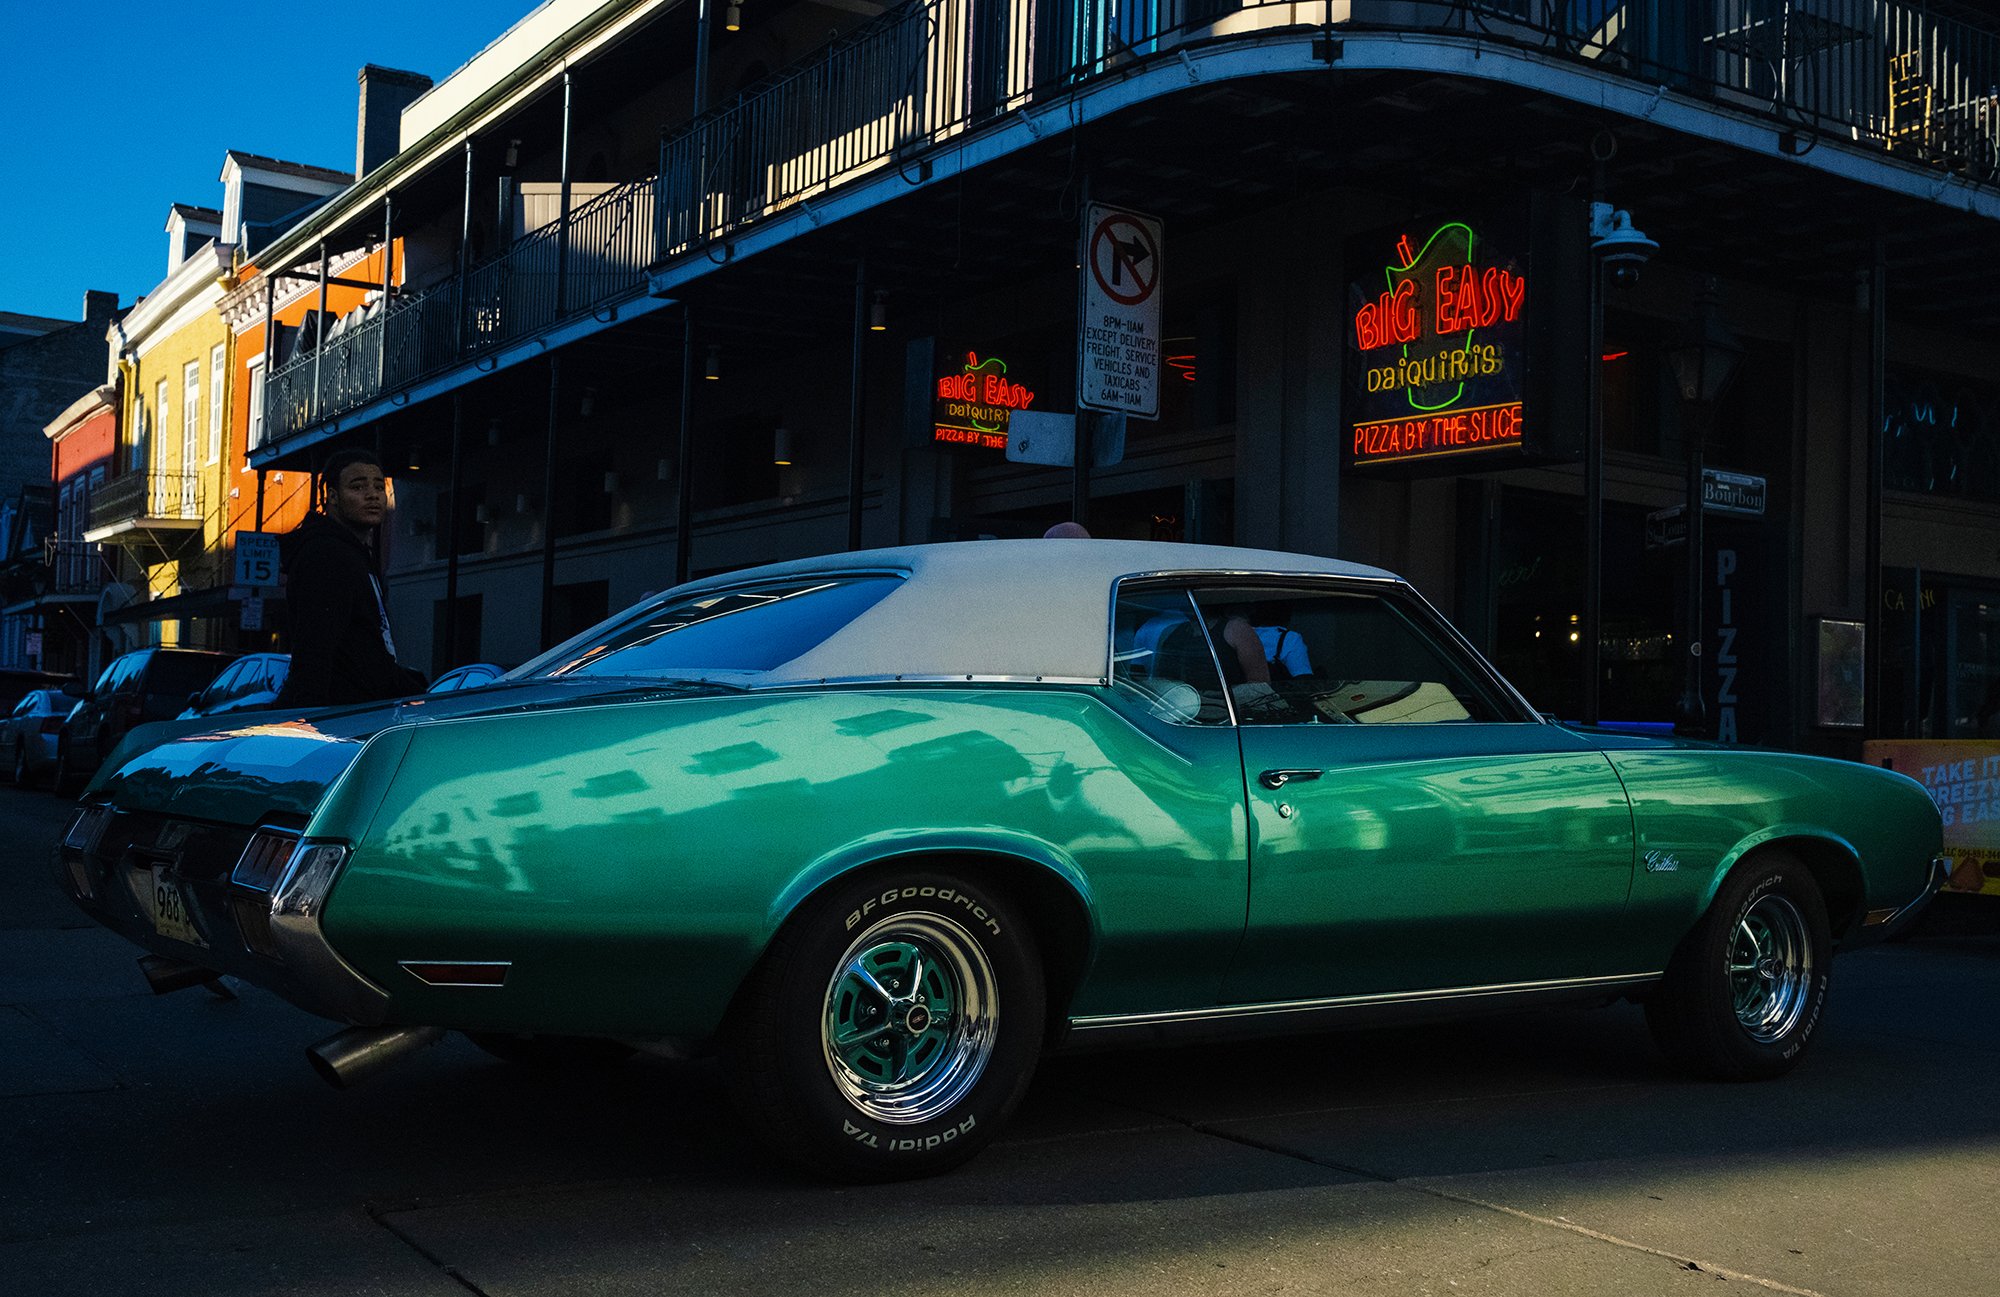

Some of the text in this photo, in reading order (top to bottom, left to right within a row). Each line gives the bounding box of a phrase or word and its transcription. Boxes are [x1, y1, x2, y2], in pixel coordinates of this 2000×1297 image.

[1355, 264, 1525, 350] BIG EASY
[1086, 326, 1117, 343] EXCEPT
[1103, 315, 1144, 334] 8PM-11AM
[1125, 348, 1156, 366] SERVICE
[1093, 357, 1132, 375] VEHICLES
[1135, 365, 1150, 379] AND
[938, 373, 1035, 410] BIG EASY
[1104, 373, 1140, 391] TAXICABS
[1101, 389, 1141, 406] 6AM-11AM
[935, 428, 965, 442] PIZZA
[967, 431, 980, 444] BY
[983, 434, 1004, 449] THE
[1354, 406, 1524, 455] PIZZA BY THE SLICE
[1704, 482, 1762, 506] Bourbon
[239, 536, 277, 549] SPEED
[242, 548, 273, 559] LIMIT
[243, 560, 271, 580] 15
[1717, 549, 1738, 743] PIZZA
[1921, 754, 2000, 786] TAKE IT
[1801, 974, 1828, 1042] Radial
[1782, 1041, 1801, 1060] T/A
[841, 1118, 879, 1149] T/A
[888, 1113, 976, 1152] Radial
